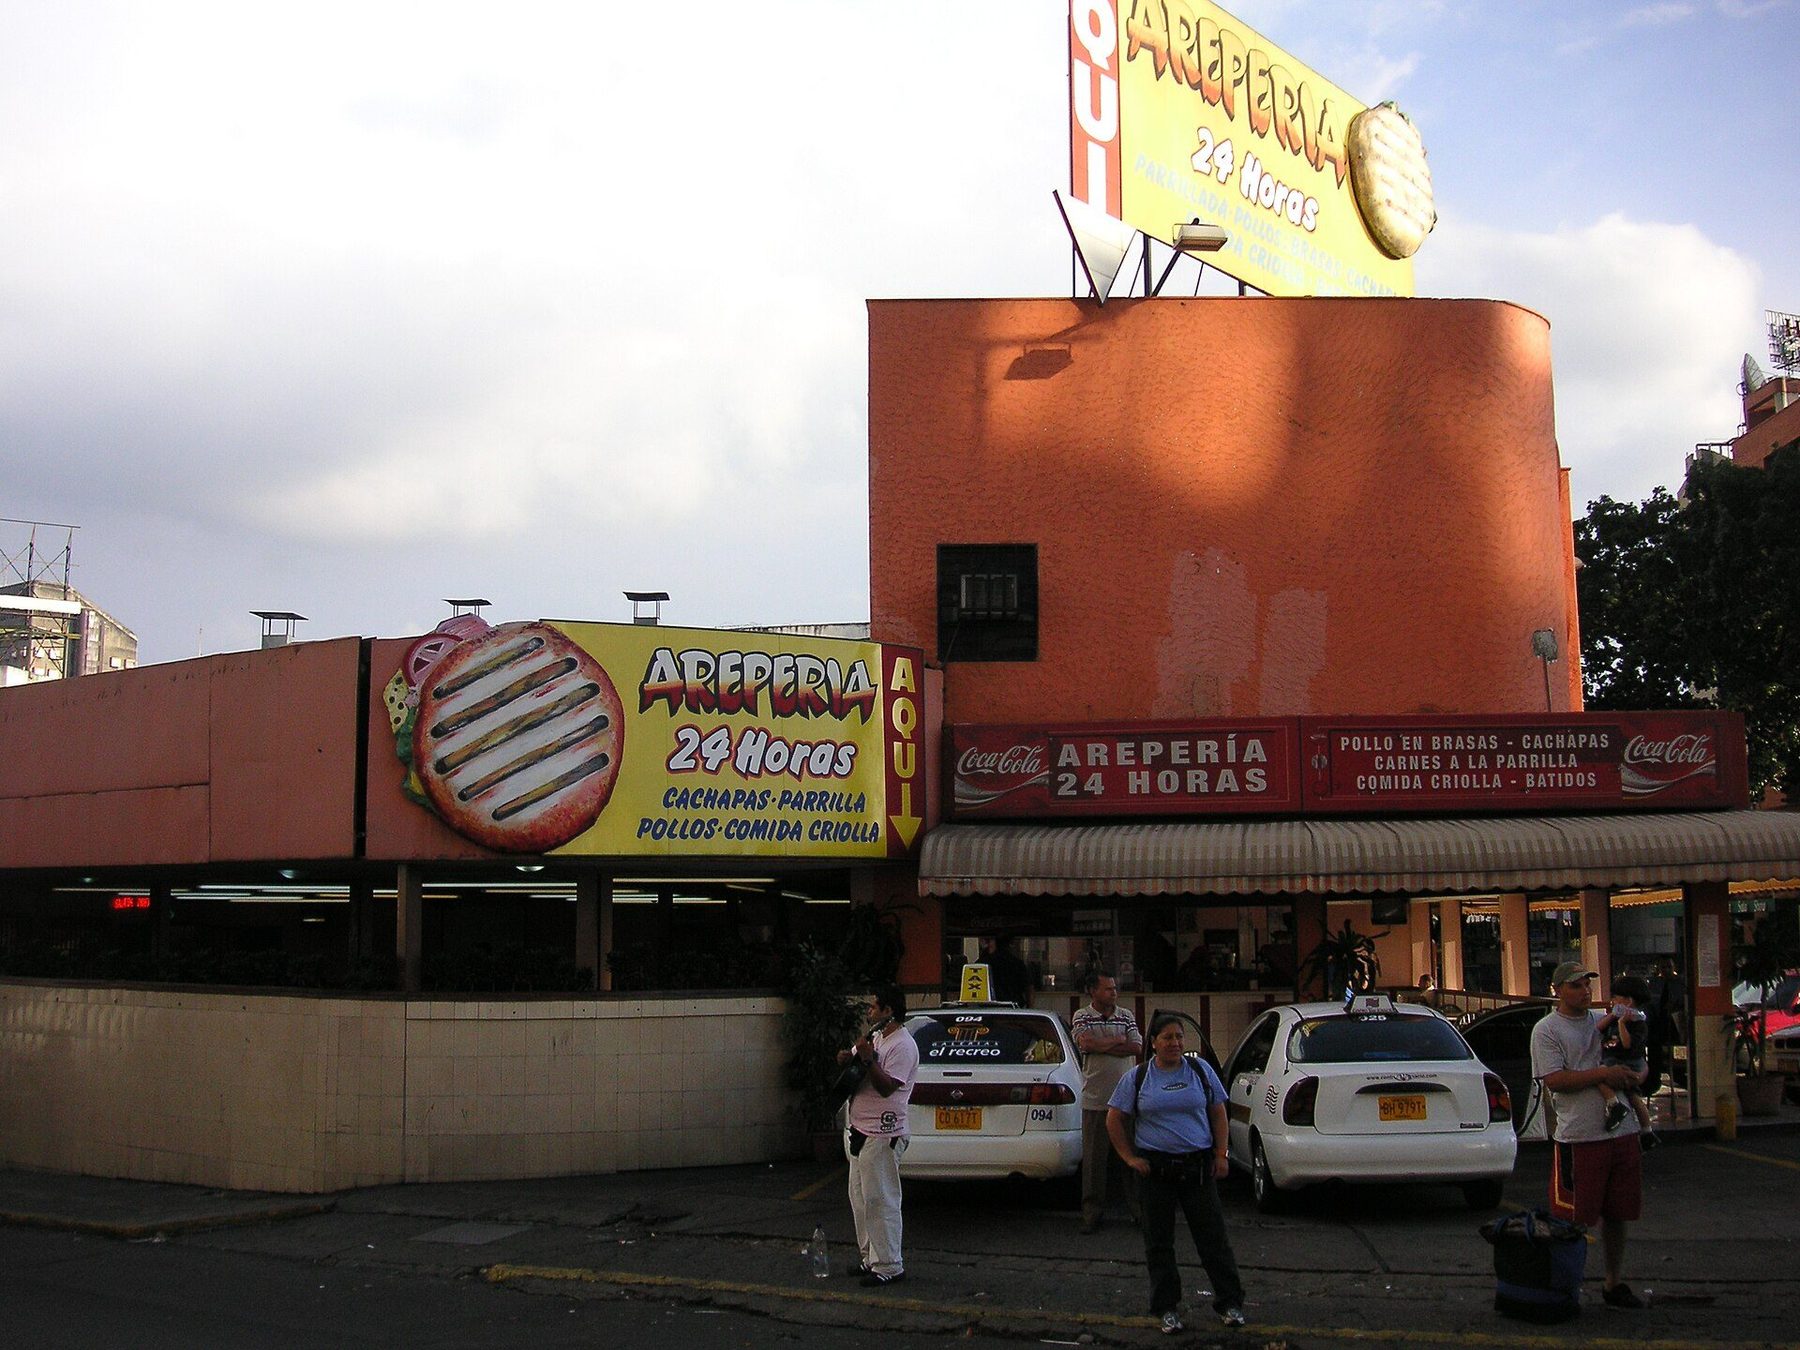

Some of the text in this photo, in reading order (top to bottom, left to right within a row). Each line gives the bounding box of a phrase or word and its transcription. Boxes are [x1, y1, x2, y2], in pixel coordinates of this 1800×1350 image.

[1126, 0, 1347, 189] AREPERIA
[1191, 127, 1320, 233] 24 Horas
[638, 647, 878, 725] AREPERIA
[667, 724, 857, 782] 24 Horas
[1057, 733, 1268, 767] AREPERÍA
[1341, 736, 1393, 751] POLLO
[1402, 736, 1422, 751] EN
[1431, 735, 1498, 750] BRASAS
[1522, 733, 1609, 749] CACHAPAS
[1624, 734, 1711, 765] Coca-Cola
[956, 745, 1047, 775] Coca-Cola
[1375, 753, 1578, 770] CARNES A LA PARRILLA
[1057, 768, 1268, 796] 24 HORAS
[1357, 775, 1423, 790] COMIDA
[1431, 773, 1502, 789] CRIOLLA
[1526, 772, 1597, 788] BATIDOS
[808, 819, 880, 843] CRIOLLA
[968, 967, 982, 999] TAXI
[955, 1015, 983, 1023] 094
[929, 1046, 1001, 1057] el recreo
[1031, 1109, 1053, 1121] 094
